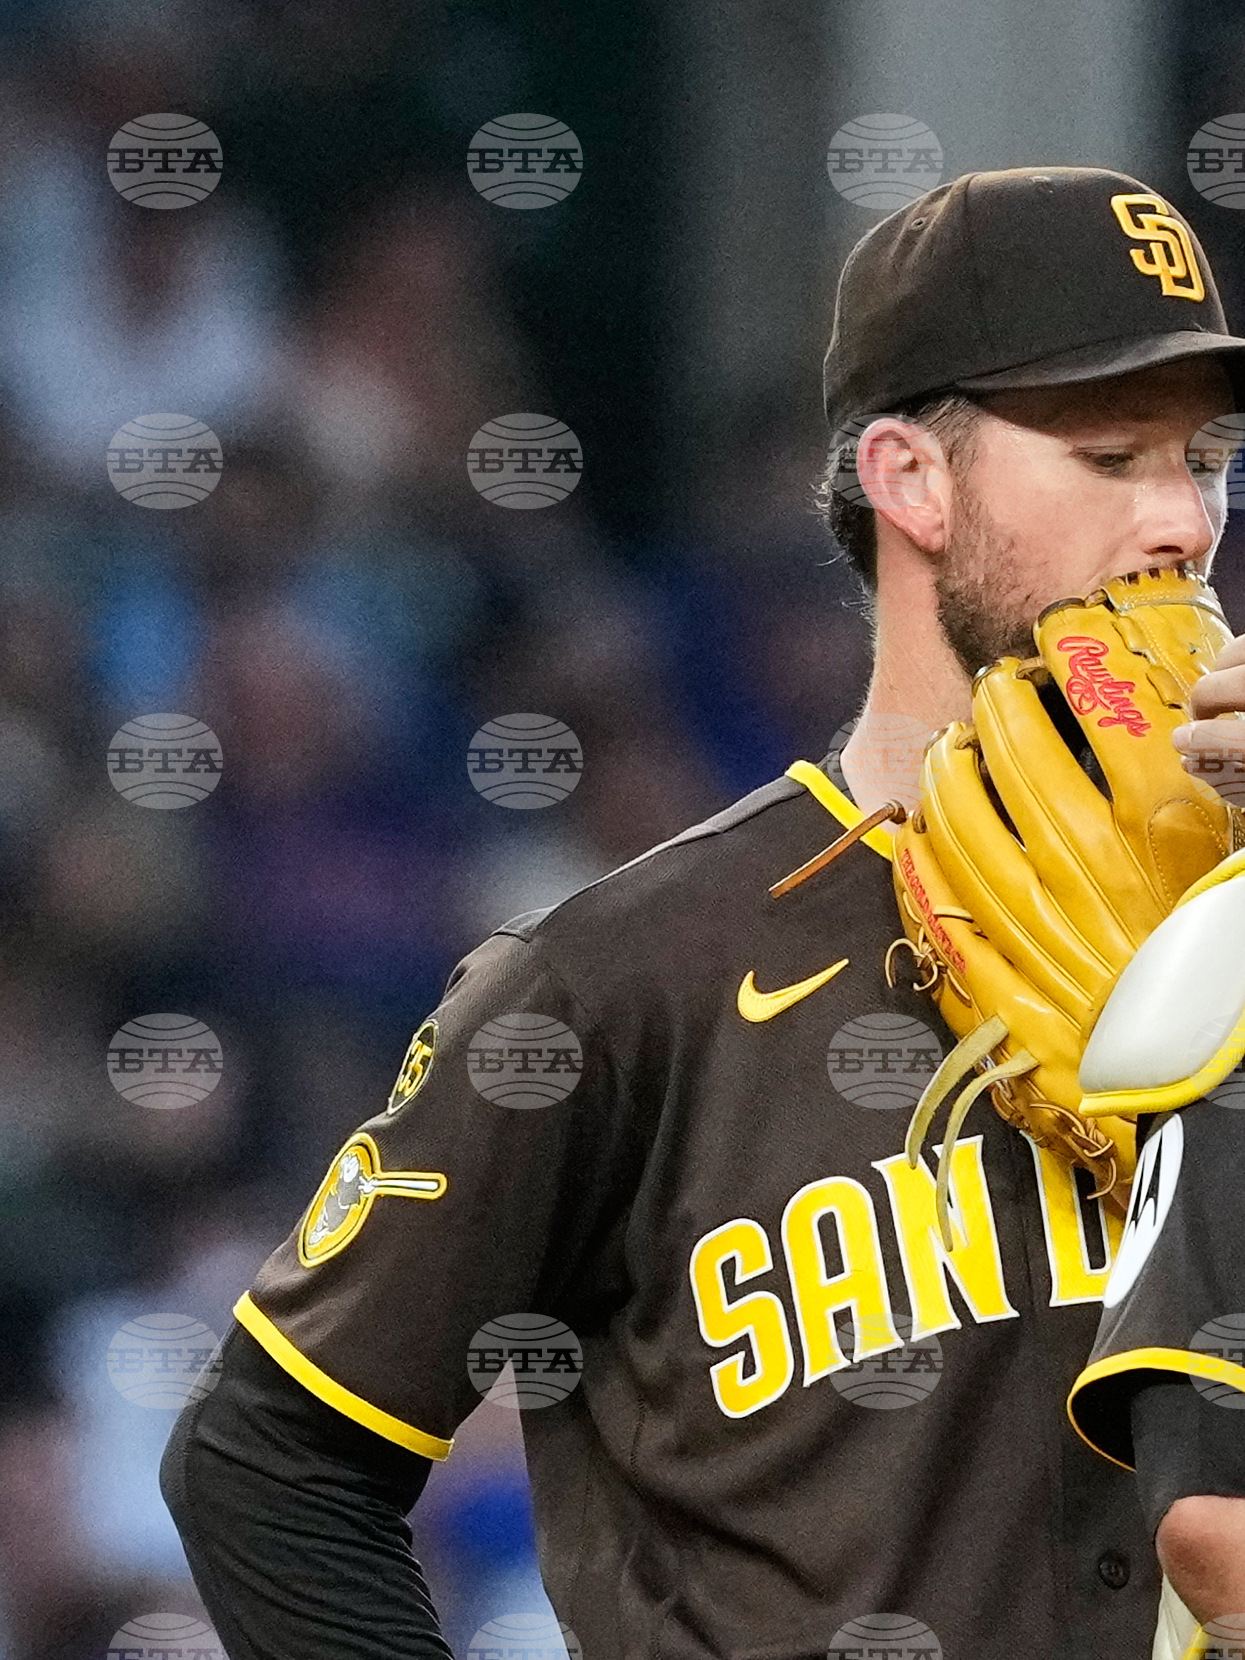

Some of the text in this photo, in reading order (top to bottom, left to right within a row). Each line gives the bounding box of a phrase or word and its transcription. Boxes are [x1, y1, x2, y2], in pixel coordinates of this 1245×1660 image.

[1111, 193, 1205, 302] SD
[1057, 636, 1151, 737] Rawlings
[689, 1134, 1020, 1420] SAN
